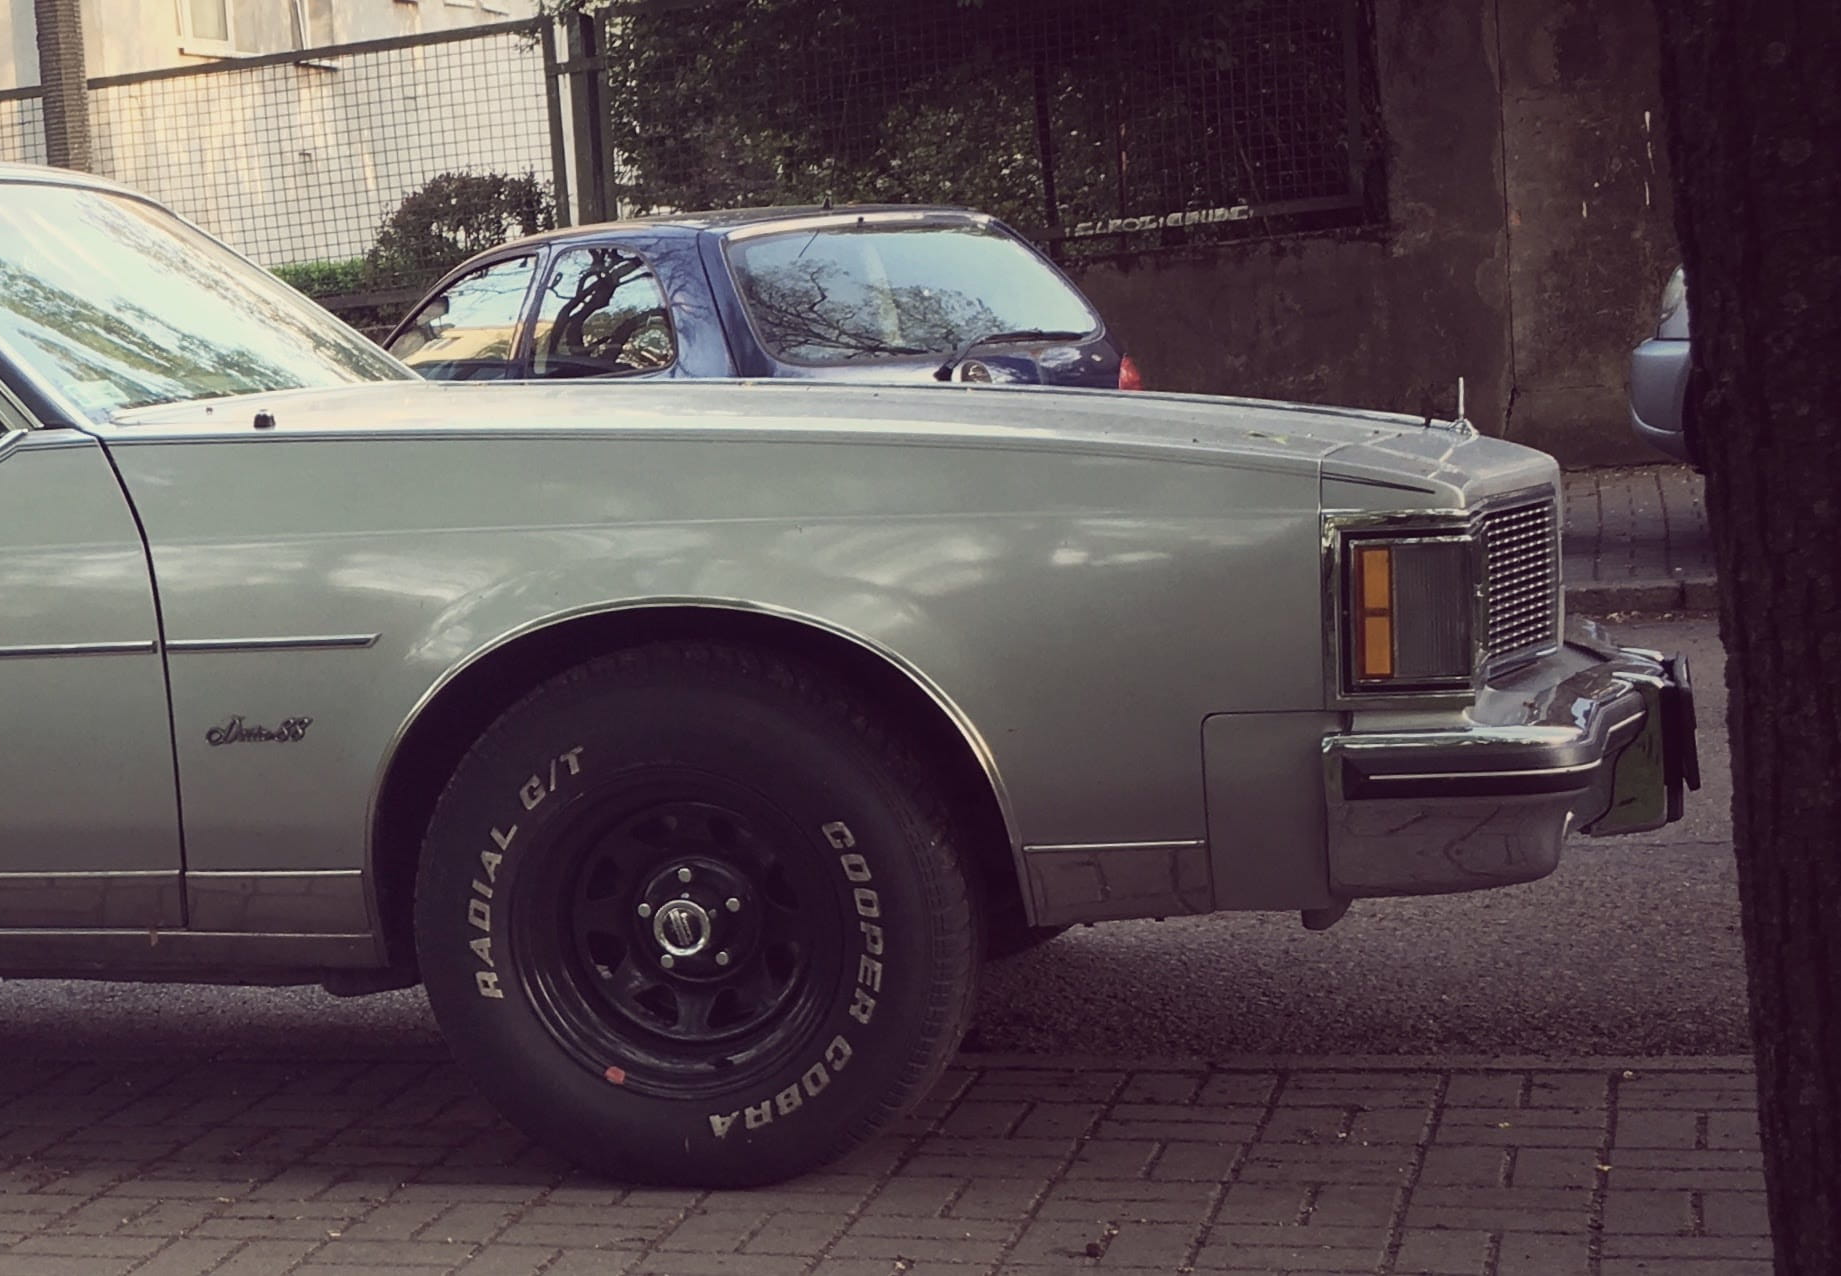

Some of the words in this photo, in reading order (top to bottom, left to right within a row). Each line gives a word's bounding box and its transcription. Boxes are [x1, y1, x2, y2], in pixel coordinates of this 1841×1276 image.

[468, 823, 518, 999] RADIAL
[519, 745, 584, 811] G/T
[821, 820, 883, 1025] COOPER
[707, 1034, 854, 1139] COBRA
